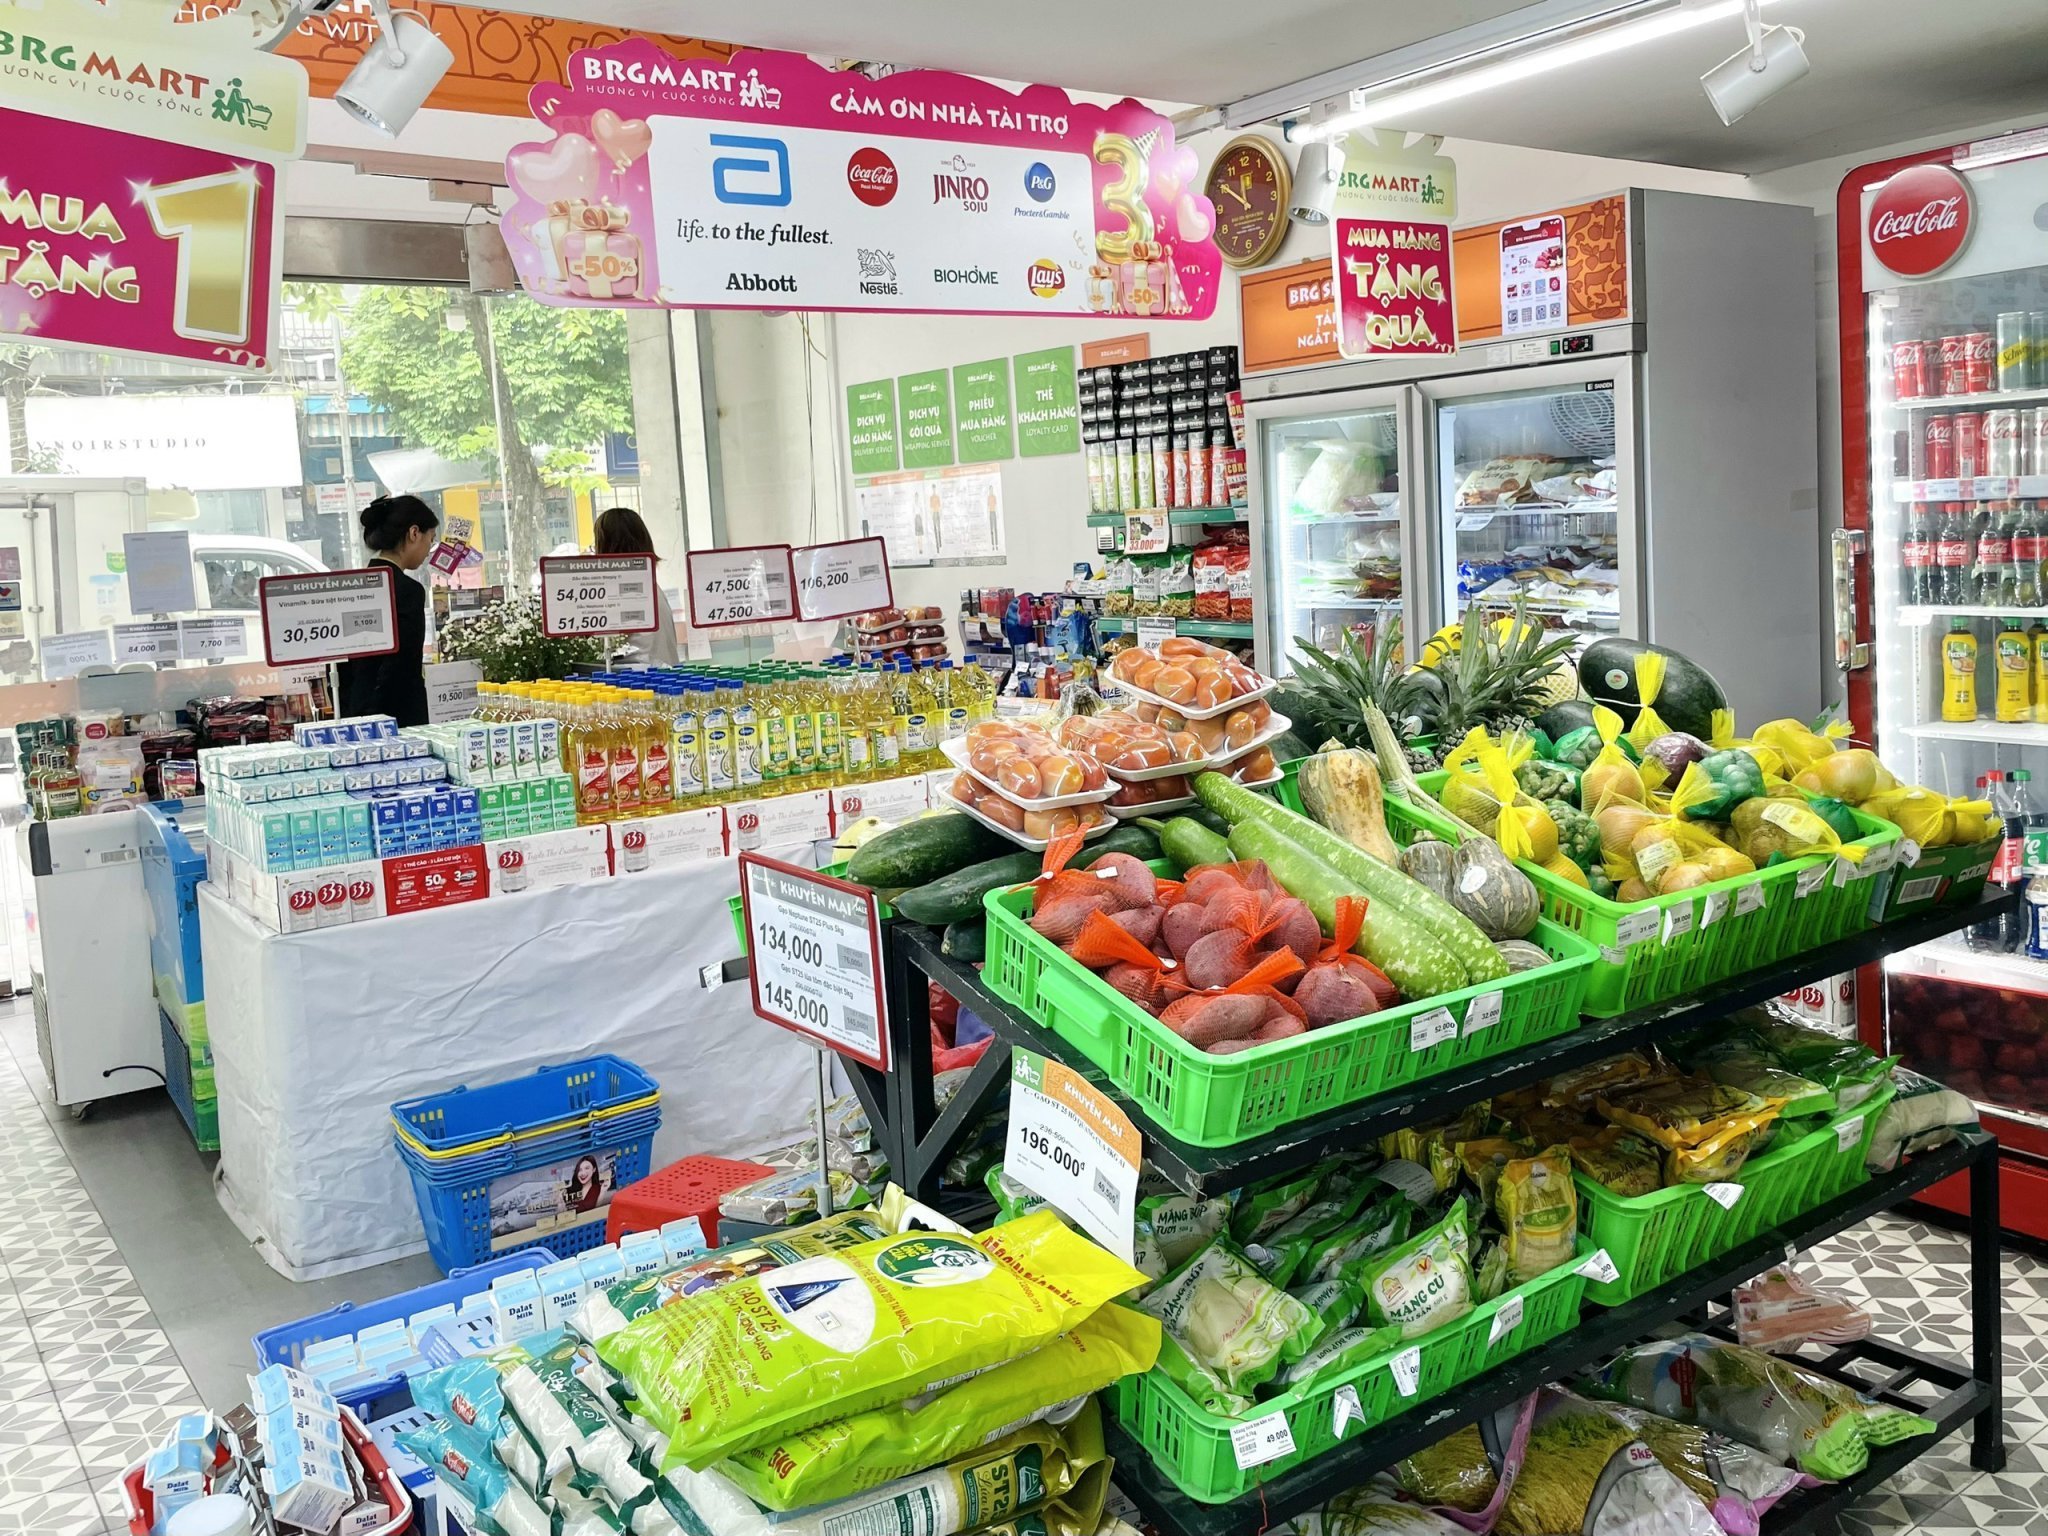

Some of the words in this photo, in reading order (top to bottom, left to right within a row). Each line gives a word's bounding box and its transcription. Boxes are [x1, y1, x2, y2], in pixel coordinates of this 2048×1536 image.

[583, 56, 736, 93] BRGMART
[68, 78, 87, 92] VỊ
[97, 84, 146, 105] CUỘC
[586, 84, 636, 97] HƯƠNG
[641, 90, 655, 100] VỊ
[662, 91, 696, 103] CUỘC
[702, 94, 736, 107] SỐNG
[830, 87, 885, 117] CẢM
[889, 97, 928, 123] ƠN
[931, 101, 983, 128] NHÀ
[986, 105, 1022, 133] TÀI
[1026, 113, 1070, 141] TRỢ
[1240, 155, 1250, 167] 12
[1227, 166, 1236, 177] 11
[1266, 171, 1273, 182] 2
[933, 174, 990, 205] JINRO
[1030, 175, 1053, 190] P&G
[1338, 171, 1420, 193] BRGMART
[1270, 190, 1278, 201] 3
[963, 200, 989, 214] SOJU
[1216, 204, 1224, 215] 9
[0, 189, 126, 245] MUA
[1267, 213, 1275, 222] 4
[1873, 195, 1962, 244] Coca-Cola
[676, 219, 709, 242] life.
[712, 220, 732, 241] to
[735, 222, 766, 243] the
[768, 223, 834, 247] fullest.
[1221, 223, 1229, 235] 8
[1258, 229, 1266, 240] 5
[1231, 236, 1239, 247] 7
[1245, 239, 1252, 250] 6
[1347, 226, 1391, 249] MUA
[1392, 225, 1441, 251] HÀNG
[143, 165, 261, 344] 1
[0, 240, 140, 305] TẶNG
[934, 267, 999, 285] BIOHOME
[1030, 266, 1063, 288] Lay's
[1349, 252, 1444, 309] TẶNG
[725, 272, 798, 294] Abbott
[1288, 284, 1320, 305] BRG
[1364, 305, 1436, 350] QUÀ
[1594, 382, 1614, 391] SANDEN
[968, 392, 995, 412] PHIẾU
[857, 415, 875, 429] DỊCH
[875, 413, 886, 427] VỤ
[909, 407, 928, 421] DỊCH
[928, 405, 940, 420] VỤ
[1018, 407, 1049, 425] KHÁCH
[1049, 404, 1077, 420] HÀNG
[909, 425, 924, 439] GÓI
[925, 421, 943, 438] QUÀ
[960, 419, 980, 432] MUA
[981, 413, 1007, 429] HÀNG
[1025, 427, 1050, 437] LOYALTY
[1051, 424, 1069, 434] CARD
[853, 433, 871, 445] GIAO
[872, 429, 893, 443] HÀNG
[970, 432, 997, 443] VOUCHER
[570, 558, 610, 571] KHUYẾN
[611, 561, 630, 570] MẠI
[293, 577, 340, 592] KHUYẾN
[341, 578, 364, 589] MẠI
[705, 578, 750, 594] 47,500
[800, 572, 849, 591] 106,200
[556, 587, 606, 603] 54,000
[708, 605, 753, 621] 47,500
[558, 615, 608, 631] 51,500
[283, 624, 340, 643] 30,500
[200, 639, 223, 648] 7,700
[437, 691, 463, 703] 19,500
[844, 796, 859, 812] 333
[738, 813, 759, 829] 333
[625, 830, 646, 848] 333
[501, 849, 522, 868] 333
[351, 879, 371, 898] 333
[425, 874, 441, 887] 50
[293, 889, 313, 909] 333
[321, 880, 343, 903] 333
[780, 878, 827, 907] KHUYẾN
[828, 897, 852, 918] MẠI
[759, 922, 823, 968] 134,000
[765, 981, 829, 1028] 145,000
[1063, 1080, 1104, 1120] KHUYẾN
[1158, 1208, 1188, 1225] MĂNG
[635, 1262, 658, 1274] Dalat
[594, 1276, 617, 1288] Dalat
[552, 1291, 577, 1304] Dalat
[1390, 1290, 1428, 1319] MĂNG
[1427, 1272, 1445, 1295] CỦ
[508, 1303, 533, 1316] Dalat
[750, 1304, 774, 1318] ST
[759, 1318, 782, 1334] 25
[1266, 1429, 1288, 1444] 49.000
[355, 1513, 378, 1525] Dalat
